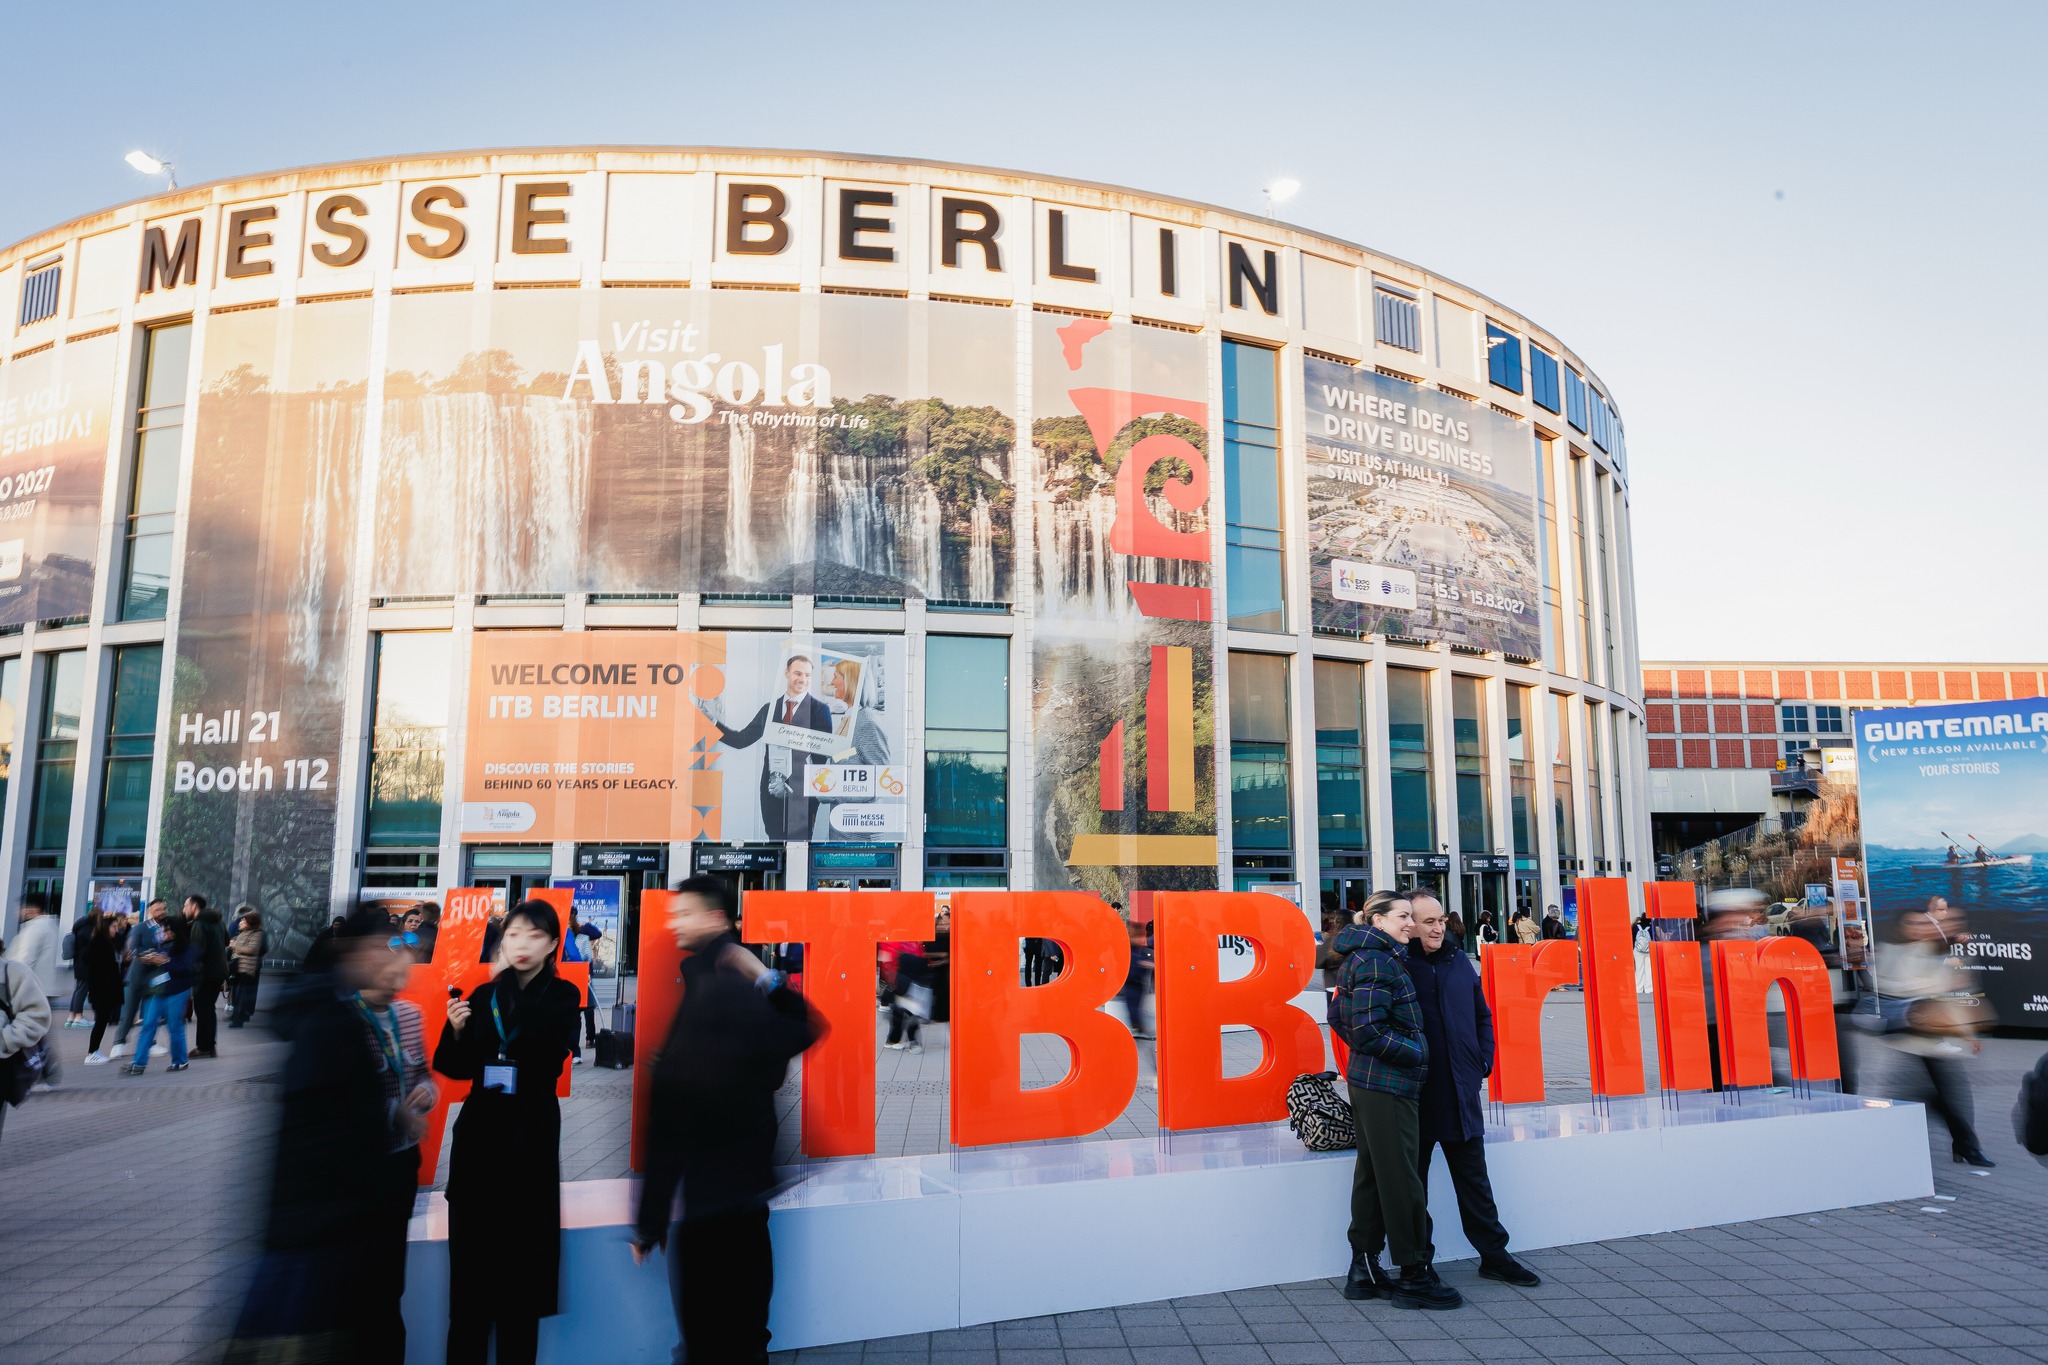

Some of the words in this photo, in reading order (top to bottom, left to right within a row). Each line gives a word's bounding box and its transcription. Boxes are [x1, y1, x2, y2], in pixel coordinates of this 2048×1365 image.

[138, 181, 571, 294] MESSE
[726, 183, 1278, 316] BERLIN
[611, 319, 699, 353] Visit
[559, 339, 835, 424] Angola
[24, 382, 72, 420] YOU
[1322, 384, 1407, 425] WHERE
[1411, 406, 1470, 442] IDEAS
[717, 409, 749, 426] The
[752, 411, 817, 430] Rhythm
[819, 412, 838, 429] of
[839, 414, 870, 430] Life
[1324, 413, 1394, 449] DRIVE
[1399, 430, 1493, 476] BUSINESS
[1326, 445, 1362, 467] VISIT
[1364, 453, 1382, 472] US
[1384, 459, 1400, 475] AT
[1402, 462, 1433, 483] HALL
[1436, 471, 1450, 487] 1.1
[1326, 463, 1374, 487] STAND
[1375, 474, 1397, 491] 124
[14, 465, 56, 498] 2027
[1433, 582, 1460, 601] 15.5
[1469, 589, 1525, 615] 15.8.2027
[491, 663, 638, 686] WELCOME
[646, 663, 685, 686] TO
[489, 694, 533, 720] ITB
[543, 694, 659, 720] BERLIN!
[178, 709, 241, 746] Hall
[248, 710, 281, 744] 21
[778, 726, 805, 739] Creating
[806, 733, 835, 744] moments
[1864, 712, 2048, 743] GUATEMALA
[788, 738, 804, 747] since
[1881, 748, 1908, 757] NEW
[1912, 745, 1962, 756] SEASON
[1966, 740, 2038, 753] AVAILABLE
[174, 756, 275, 794] Booth
[283, 758, 330, 792] 112
[484, 762, 550, 776] DISCOVER
[553, 762, 578, 776] THE
[581, 762, 636, 776] STORIES
[843, 769, 868, 782] ITB
[1919, 765, 1950, 778] YOUR
[1951, 762, 2001, 775] STORIES
[484, 779, 533, 790] BEHIND
[536, 779, 552, 790] 60
[556, 779, 599, 790] YEARS
[602, 779, 620, 790] OF
[623, 779, 679, 791] LEGACY.
[843, 785, 868, 793] BERLIN
[496, 810, 520, 819] Angola
[1966, 943, 2032, 961] STORIES
